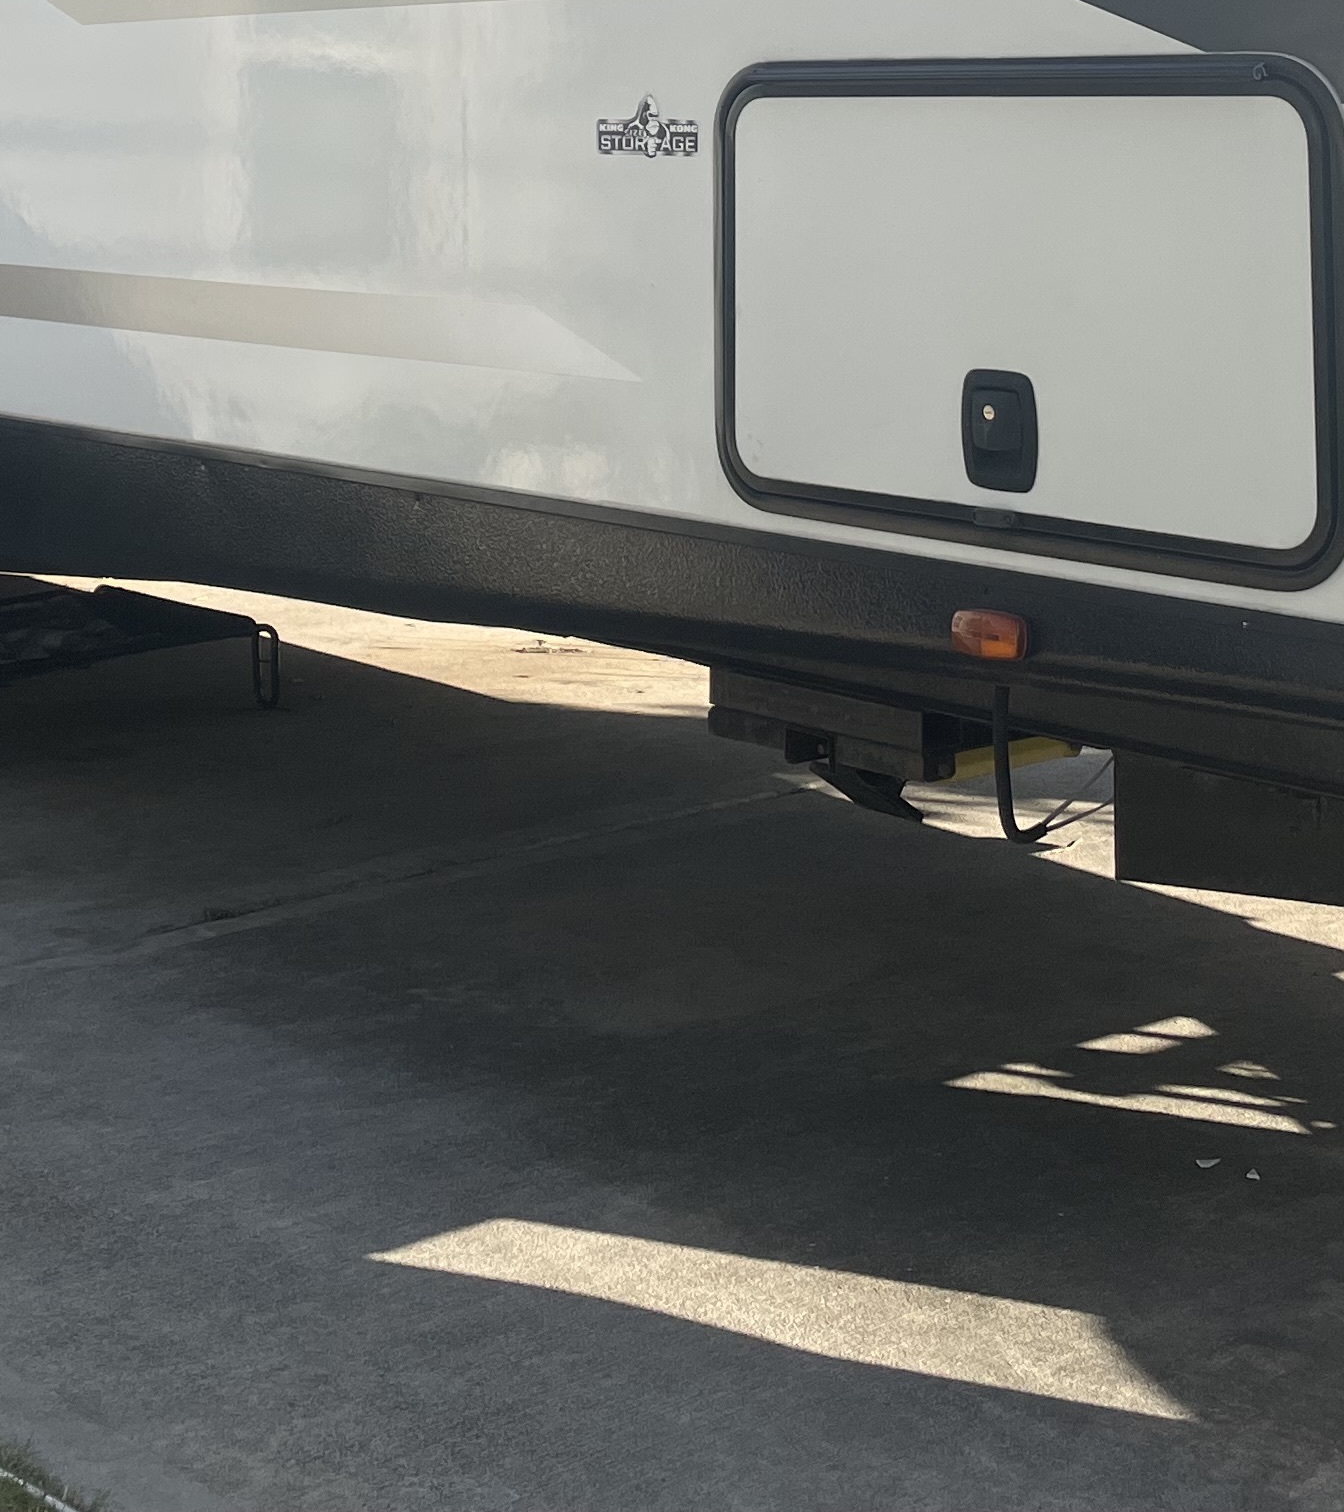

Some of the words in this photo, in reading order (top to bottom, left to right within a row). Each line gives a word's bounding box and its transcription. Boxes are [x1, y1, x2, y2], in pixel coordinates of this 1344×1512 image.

[599, 123, 624, 132] KING
[669, 124, 698, 133] KONG
[600, 134, 696, 152] STORAGE
